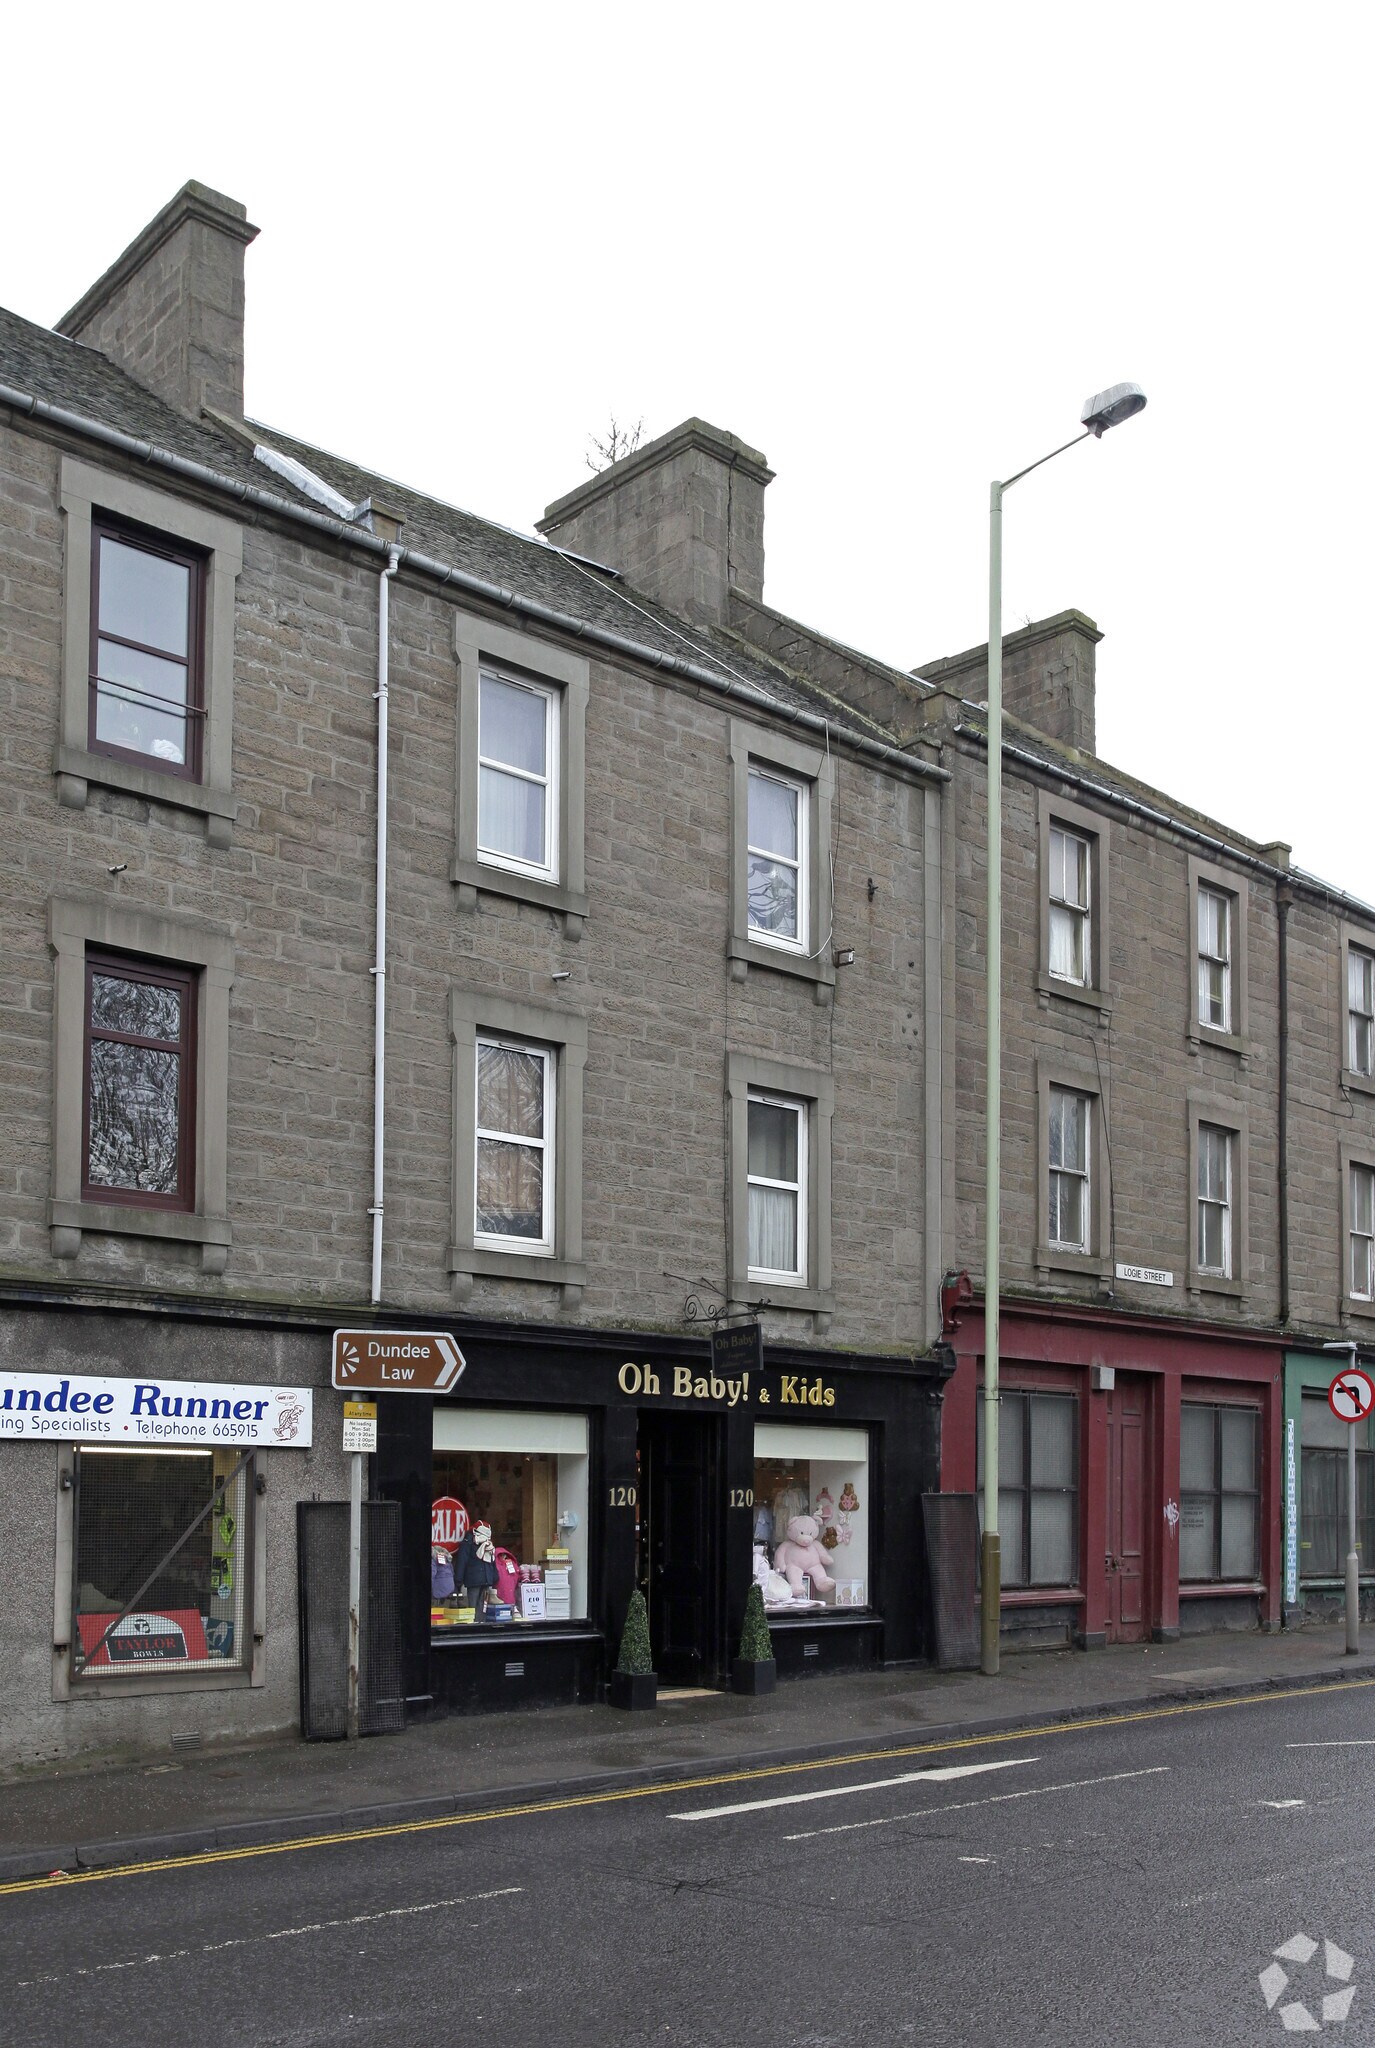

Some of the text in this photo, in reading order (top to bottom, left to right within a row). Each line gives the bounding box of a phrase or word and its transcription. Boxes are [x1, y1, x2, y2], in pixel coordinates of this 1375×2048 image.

[1123, 1267, 1166, 1282] LOGIE STREET
[368, 1341, 430, 1358] Dundee
[715, 1337, 729, 1350] Oh
[381, 1363, 415, 1380] Law
[618, 1362, 836, 1407] Oh Baby! & Kids
[130, 1384, 269, 1421] Runner
[32, 1415, 111, 1433] Specialists
[136, 1420, 206, 1437] Telephone
[212, 1423, 258, 1437] 665915
[609, 1487, 754, 1507] 120 120
[115, 1637, 176, 1650] TAYLOR
[133, 1650, 164, 1658] BOWLS
